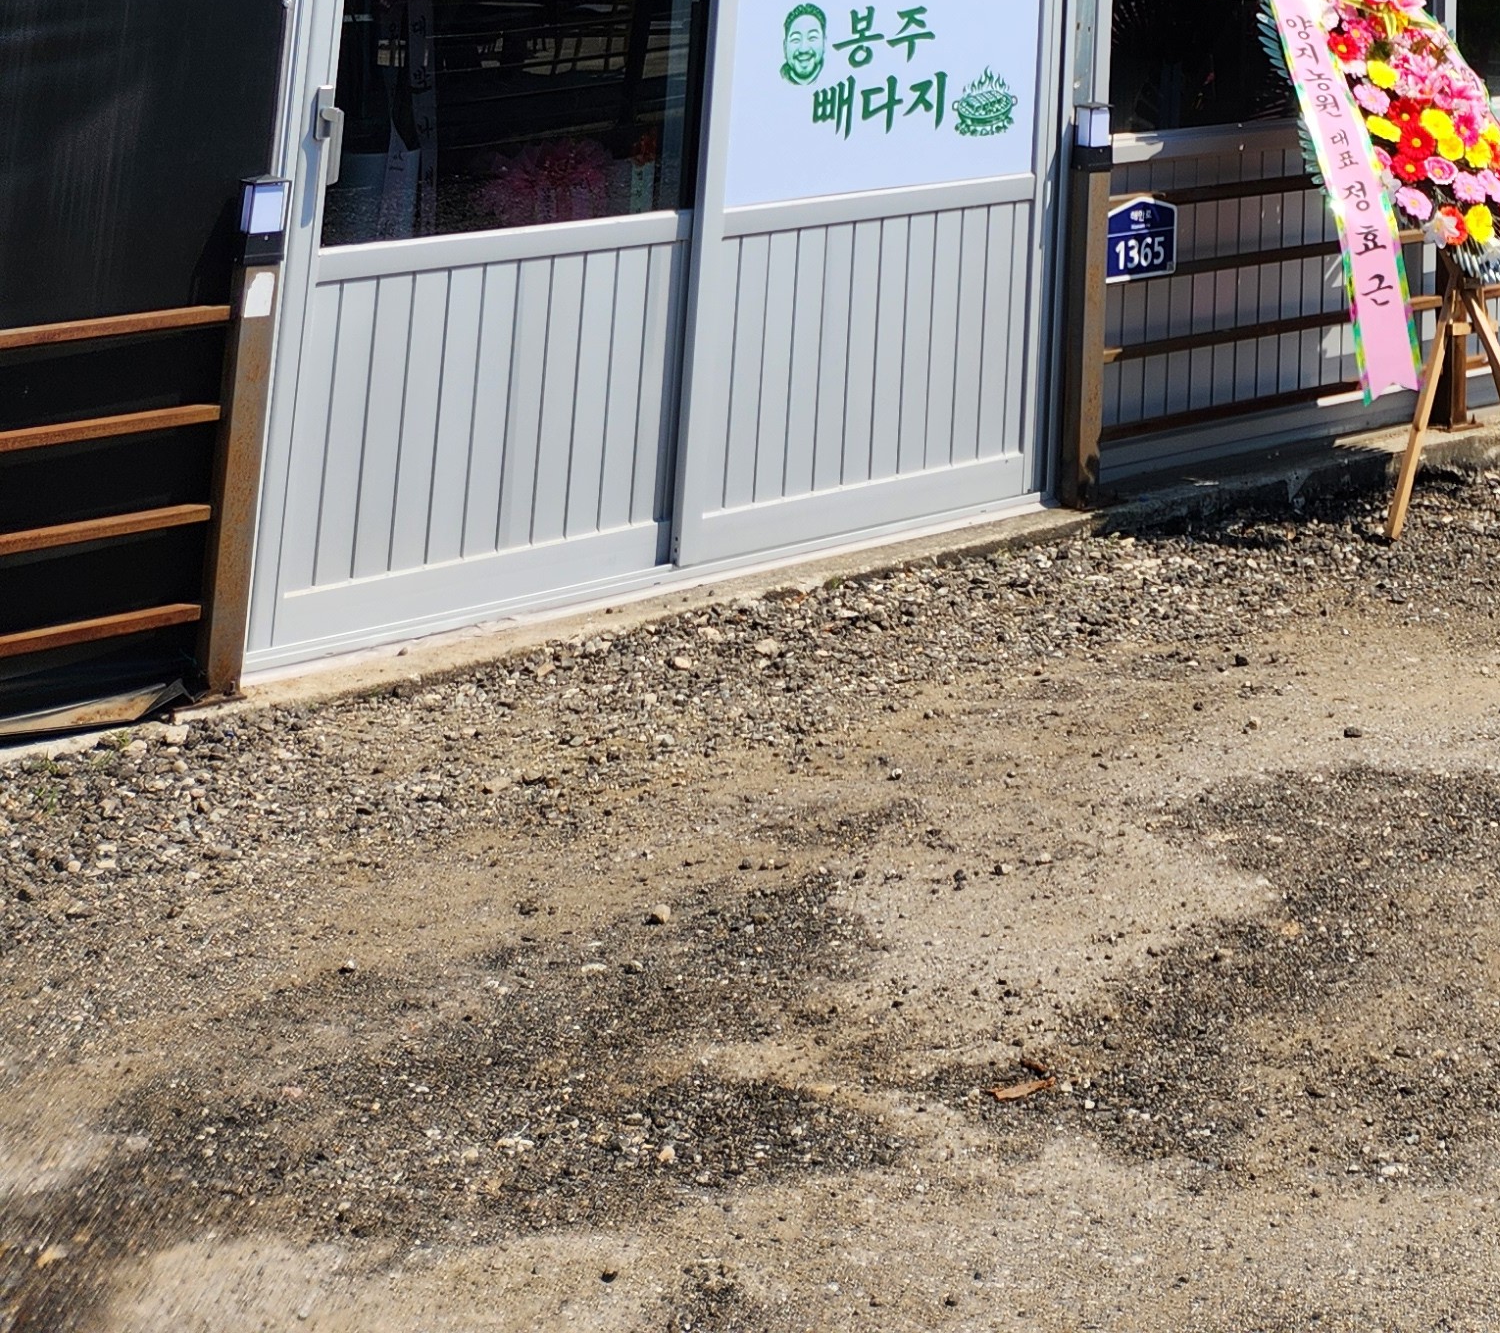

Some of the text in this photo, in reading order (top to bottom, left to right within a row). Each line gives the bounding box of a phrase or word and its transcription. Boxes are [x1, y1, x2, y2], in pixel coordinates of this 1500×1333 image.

[832, 5, 935, 69] 봉주
[812, 71, 948, 141] 빼다지
[1330, 129, 1359, 170] 대표
[1115, 237, 1165, 270] 1365
